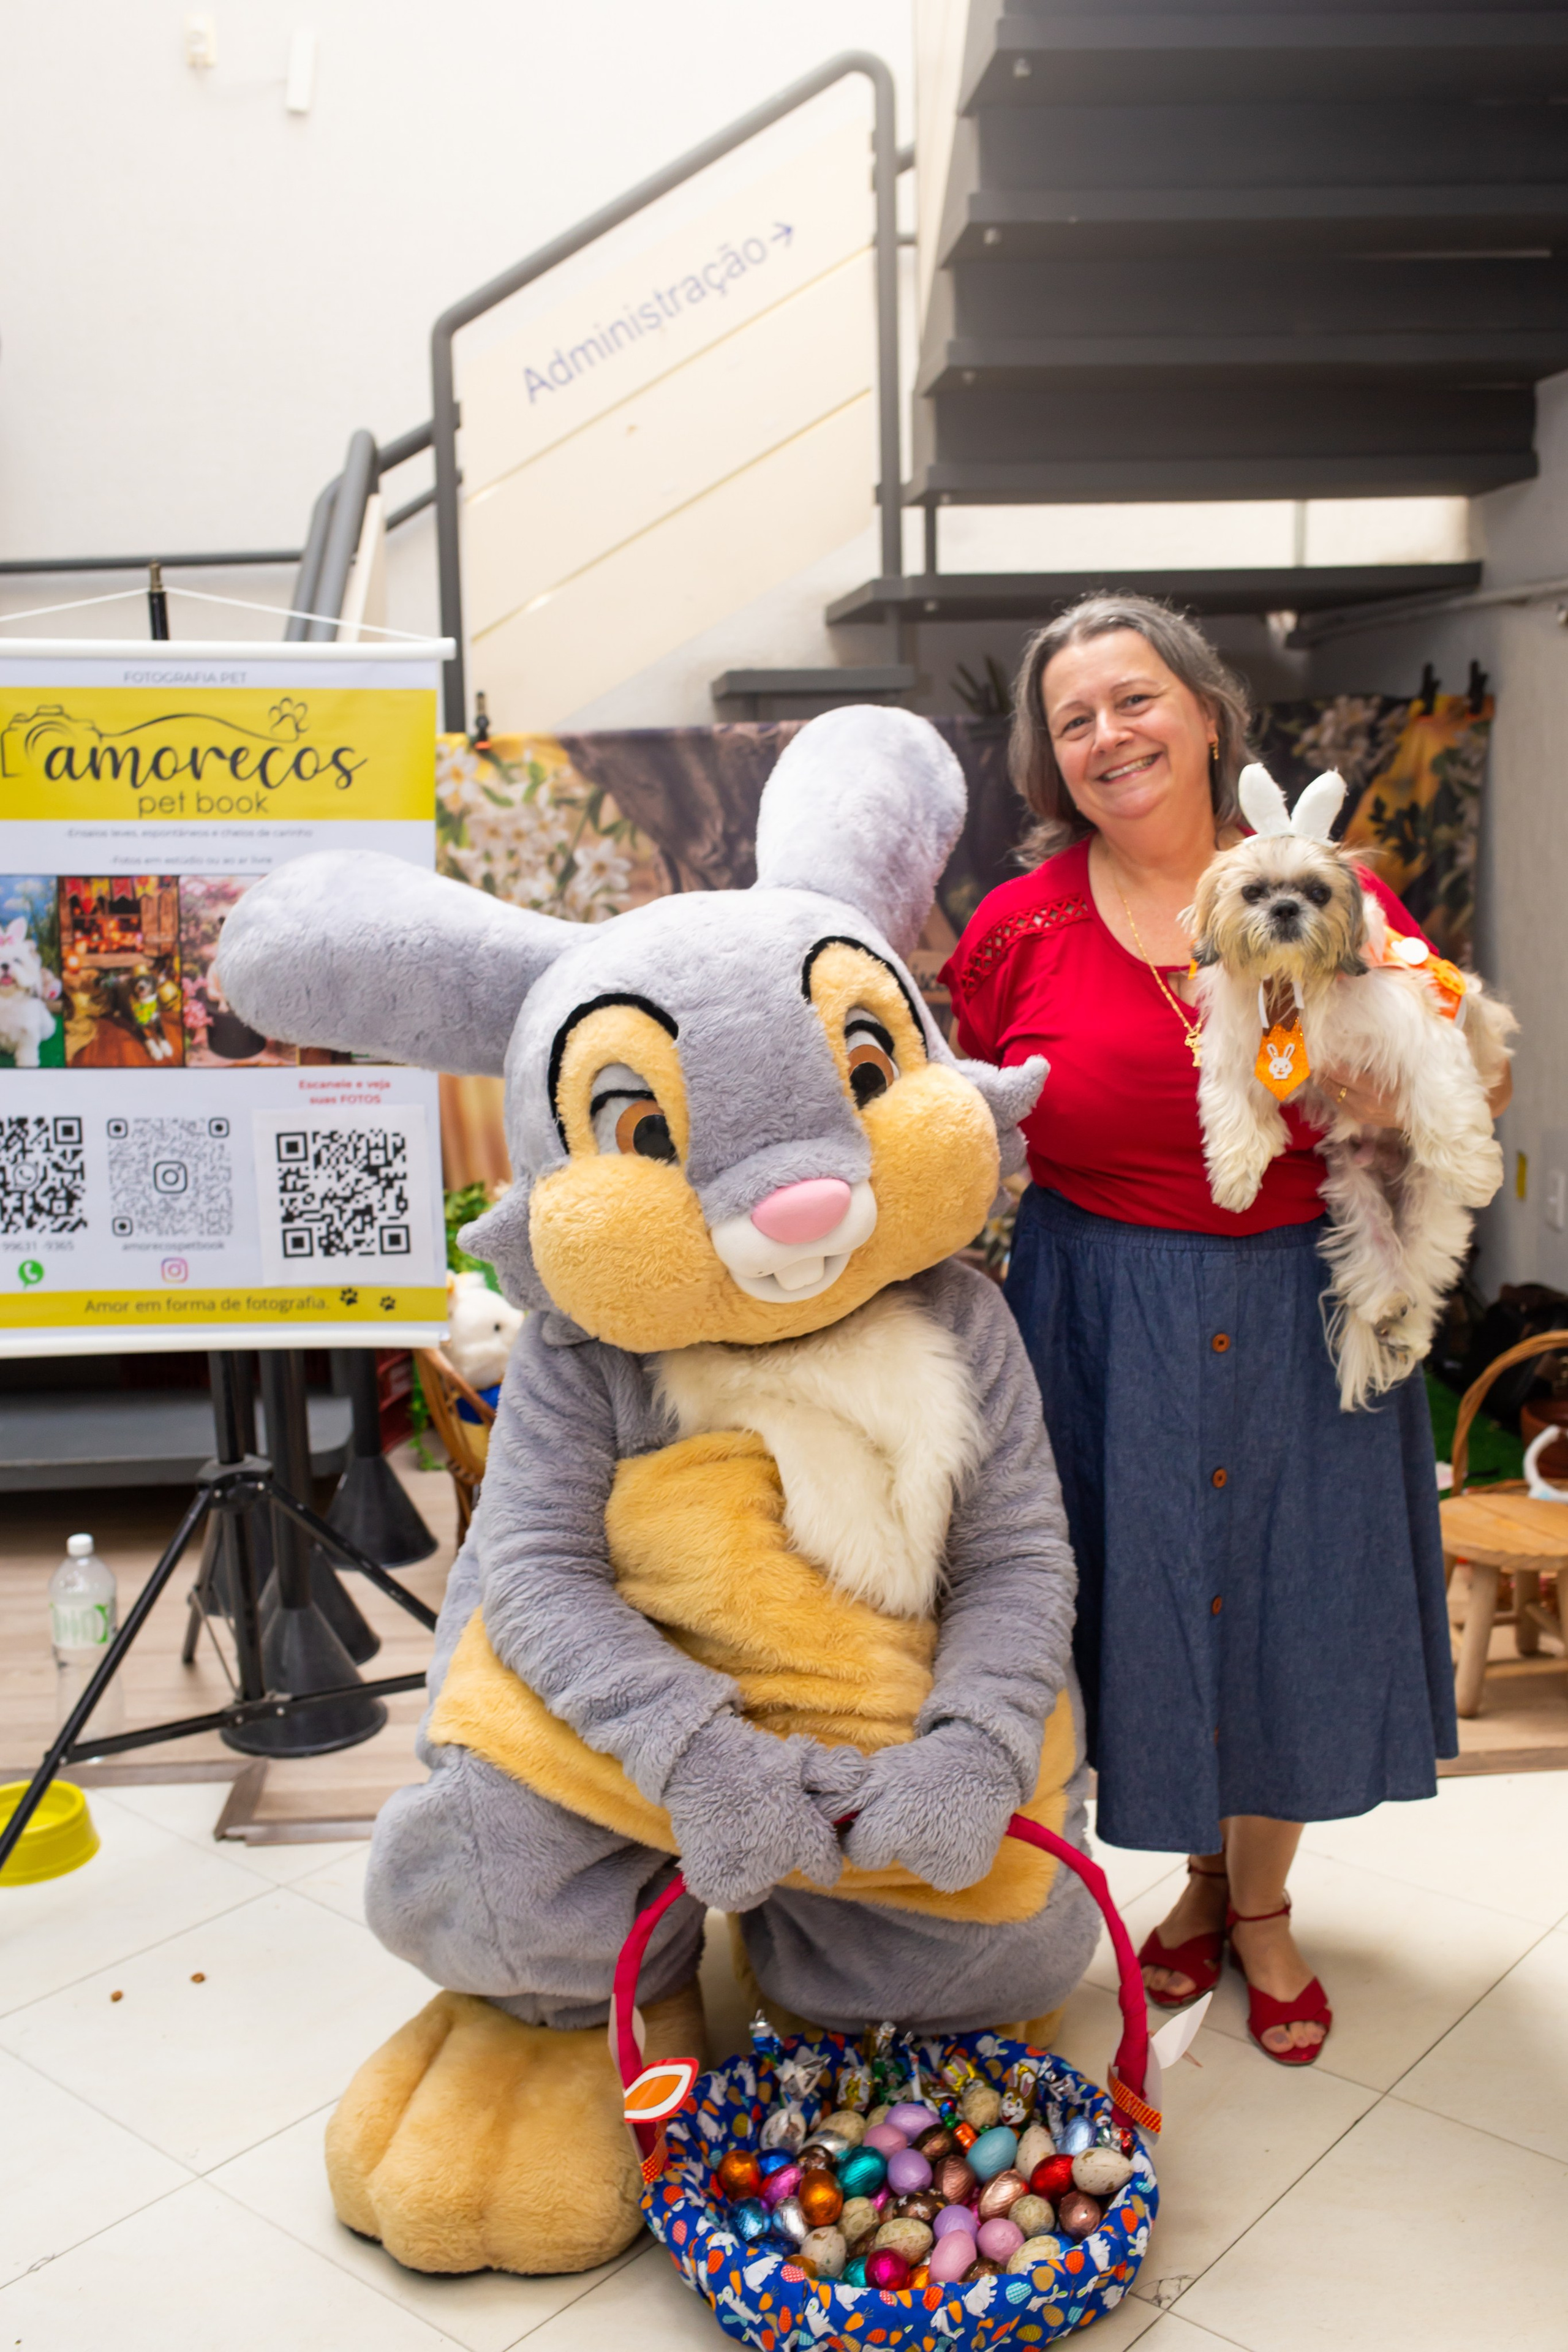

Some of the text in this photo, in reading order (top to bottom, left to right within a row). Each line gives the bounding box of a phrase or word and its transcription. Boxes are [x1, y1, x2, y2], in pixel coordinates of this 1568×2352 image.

[523, 237, 767, 404] Administração
[124, 671, 247, 684] FOTOGRAFIA PET
[45, 746, 368, 790] amorecos
[138, 790, 269, 818] pet book
[257, 829, 270, 838] de
[299, 1080, 352, 1089] Escaneie
[367, 1079, 391, 1091] veja
[341, 1095, 381, 1103] FOTOS
[85, 1295, 330, 1314] Amor em forma de fotografia.
